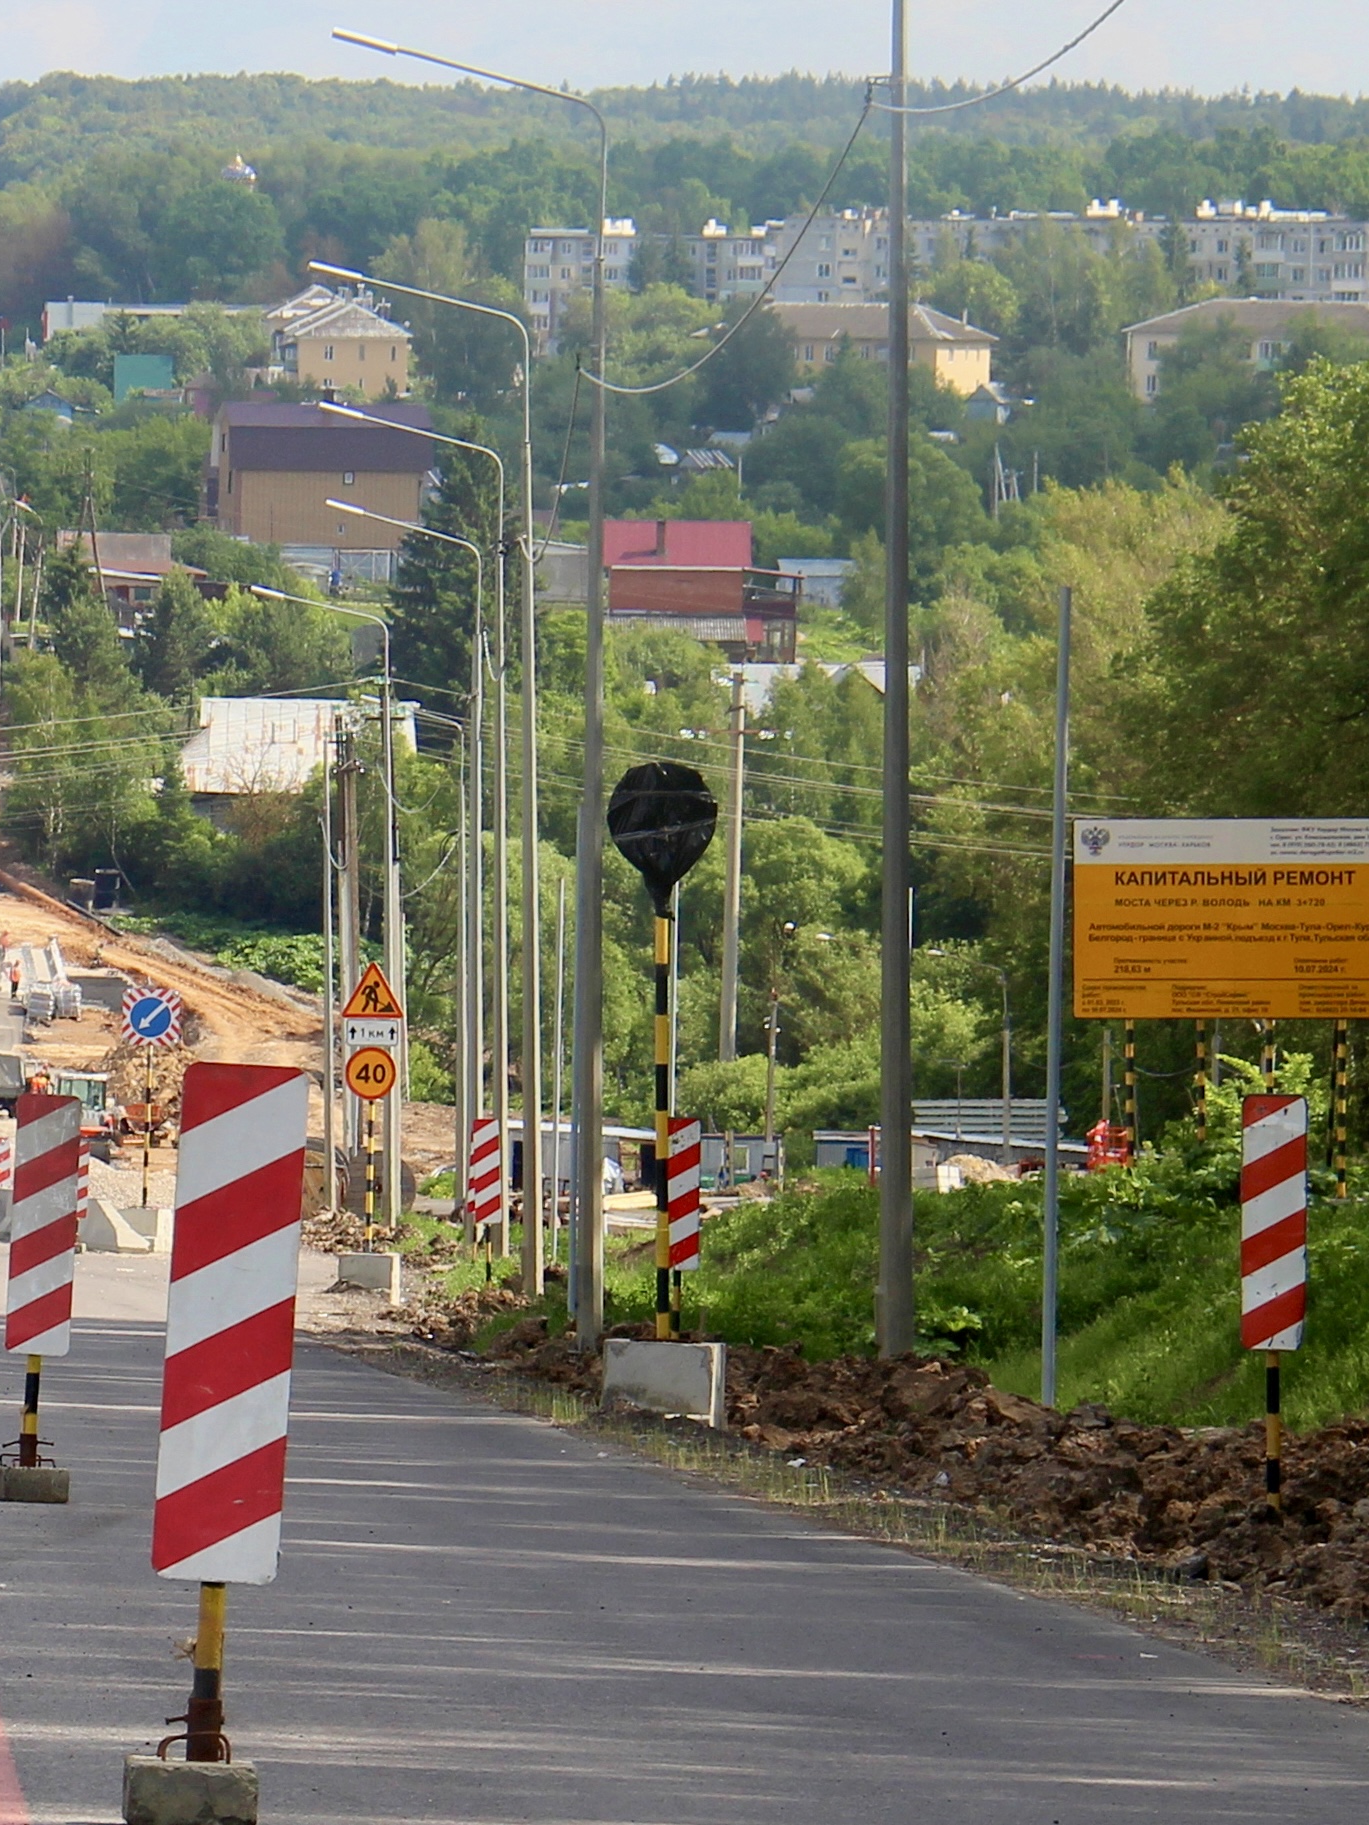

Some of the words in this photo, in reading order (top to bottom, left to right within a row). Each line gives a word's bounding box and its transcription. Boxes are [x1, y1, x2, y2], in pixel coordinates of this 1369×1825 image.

[1115, 868, 1266, 886] КАПИТАЛЬНЫЙ
[1273, 870, 1356, 886] РЕМОНТ
[1115, 898, 1151, 907] МОСТА
[1154, 898, 1188, 907] ЧЕРЕЗ
[1202, 898, 1250, 908] ВОЛОДЬ
[1258, 898, 1273, 907] НА
[1276, 898, 1291, 907] КМ
[1089, 922, 1165, 932] Автомобильной
[1166, 924, 1201, 932] дороги
[355, 1063, 386, 1084] 40
